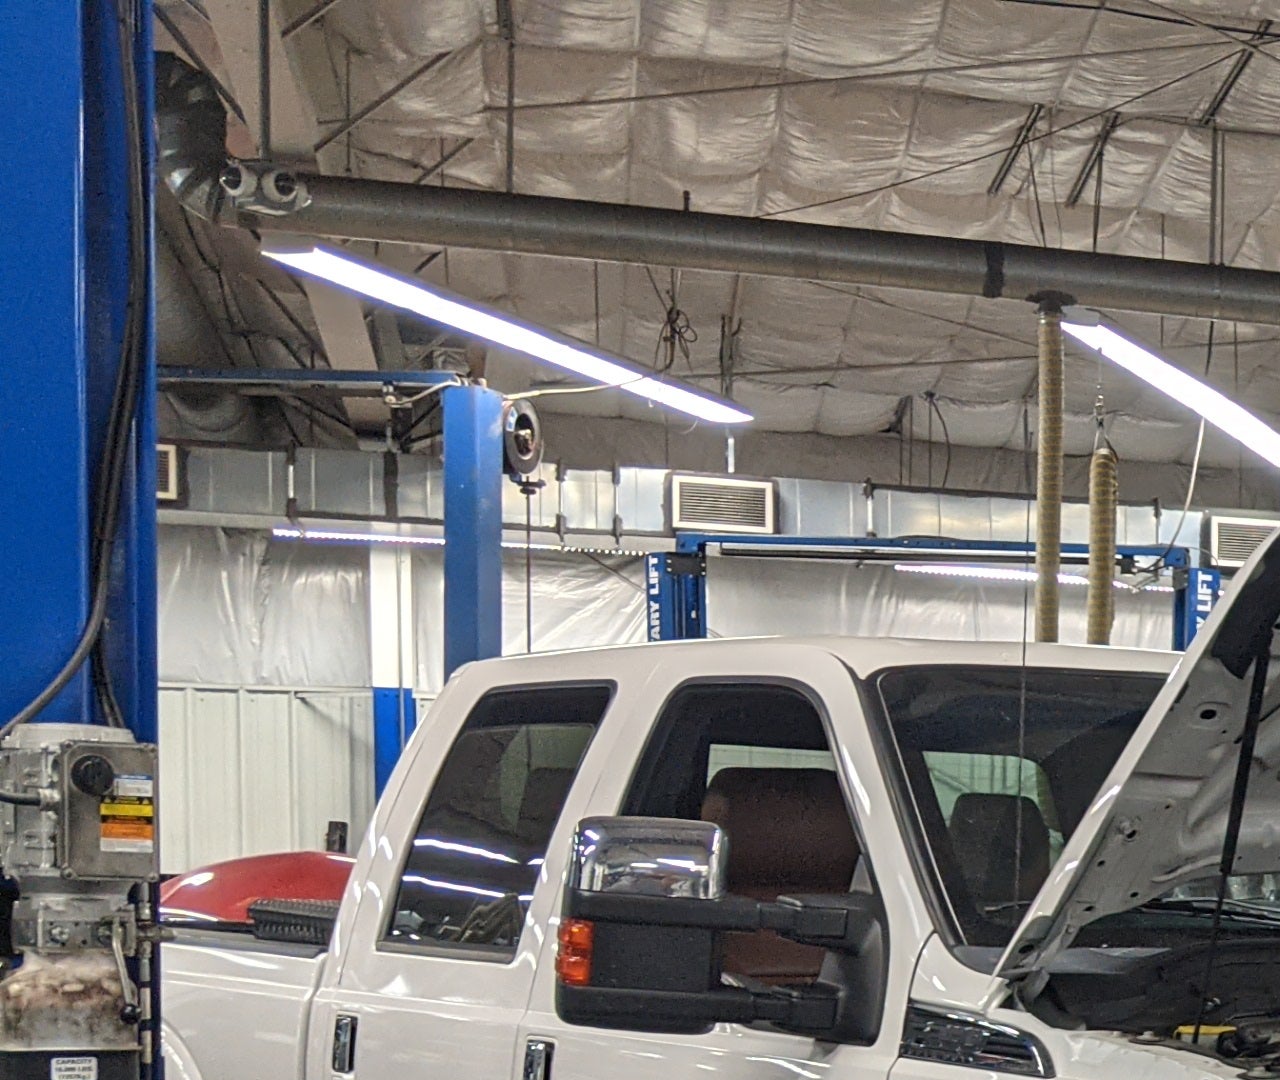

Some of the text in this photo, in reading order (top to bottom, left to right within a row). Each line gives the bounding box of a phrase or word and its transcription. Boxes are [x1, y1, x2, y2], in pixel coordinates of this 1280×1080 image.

[648, 555, 661, 641] ARY LIFT
[1196, 570, 1213, 612] LIFT
